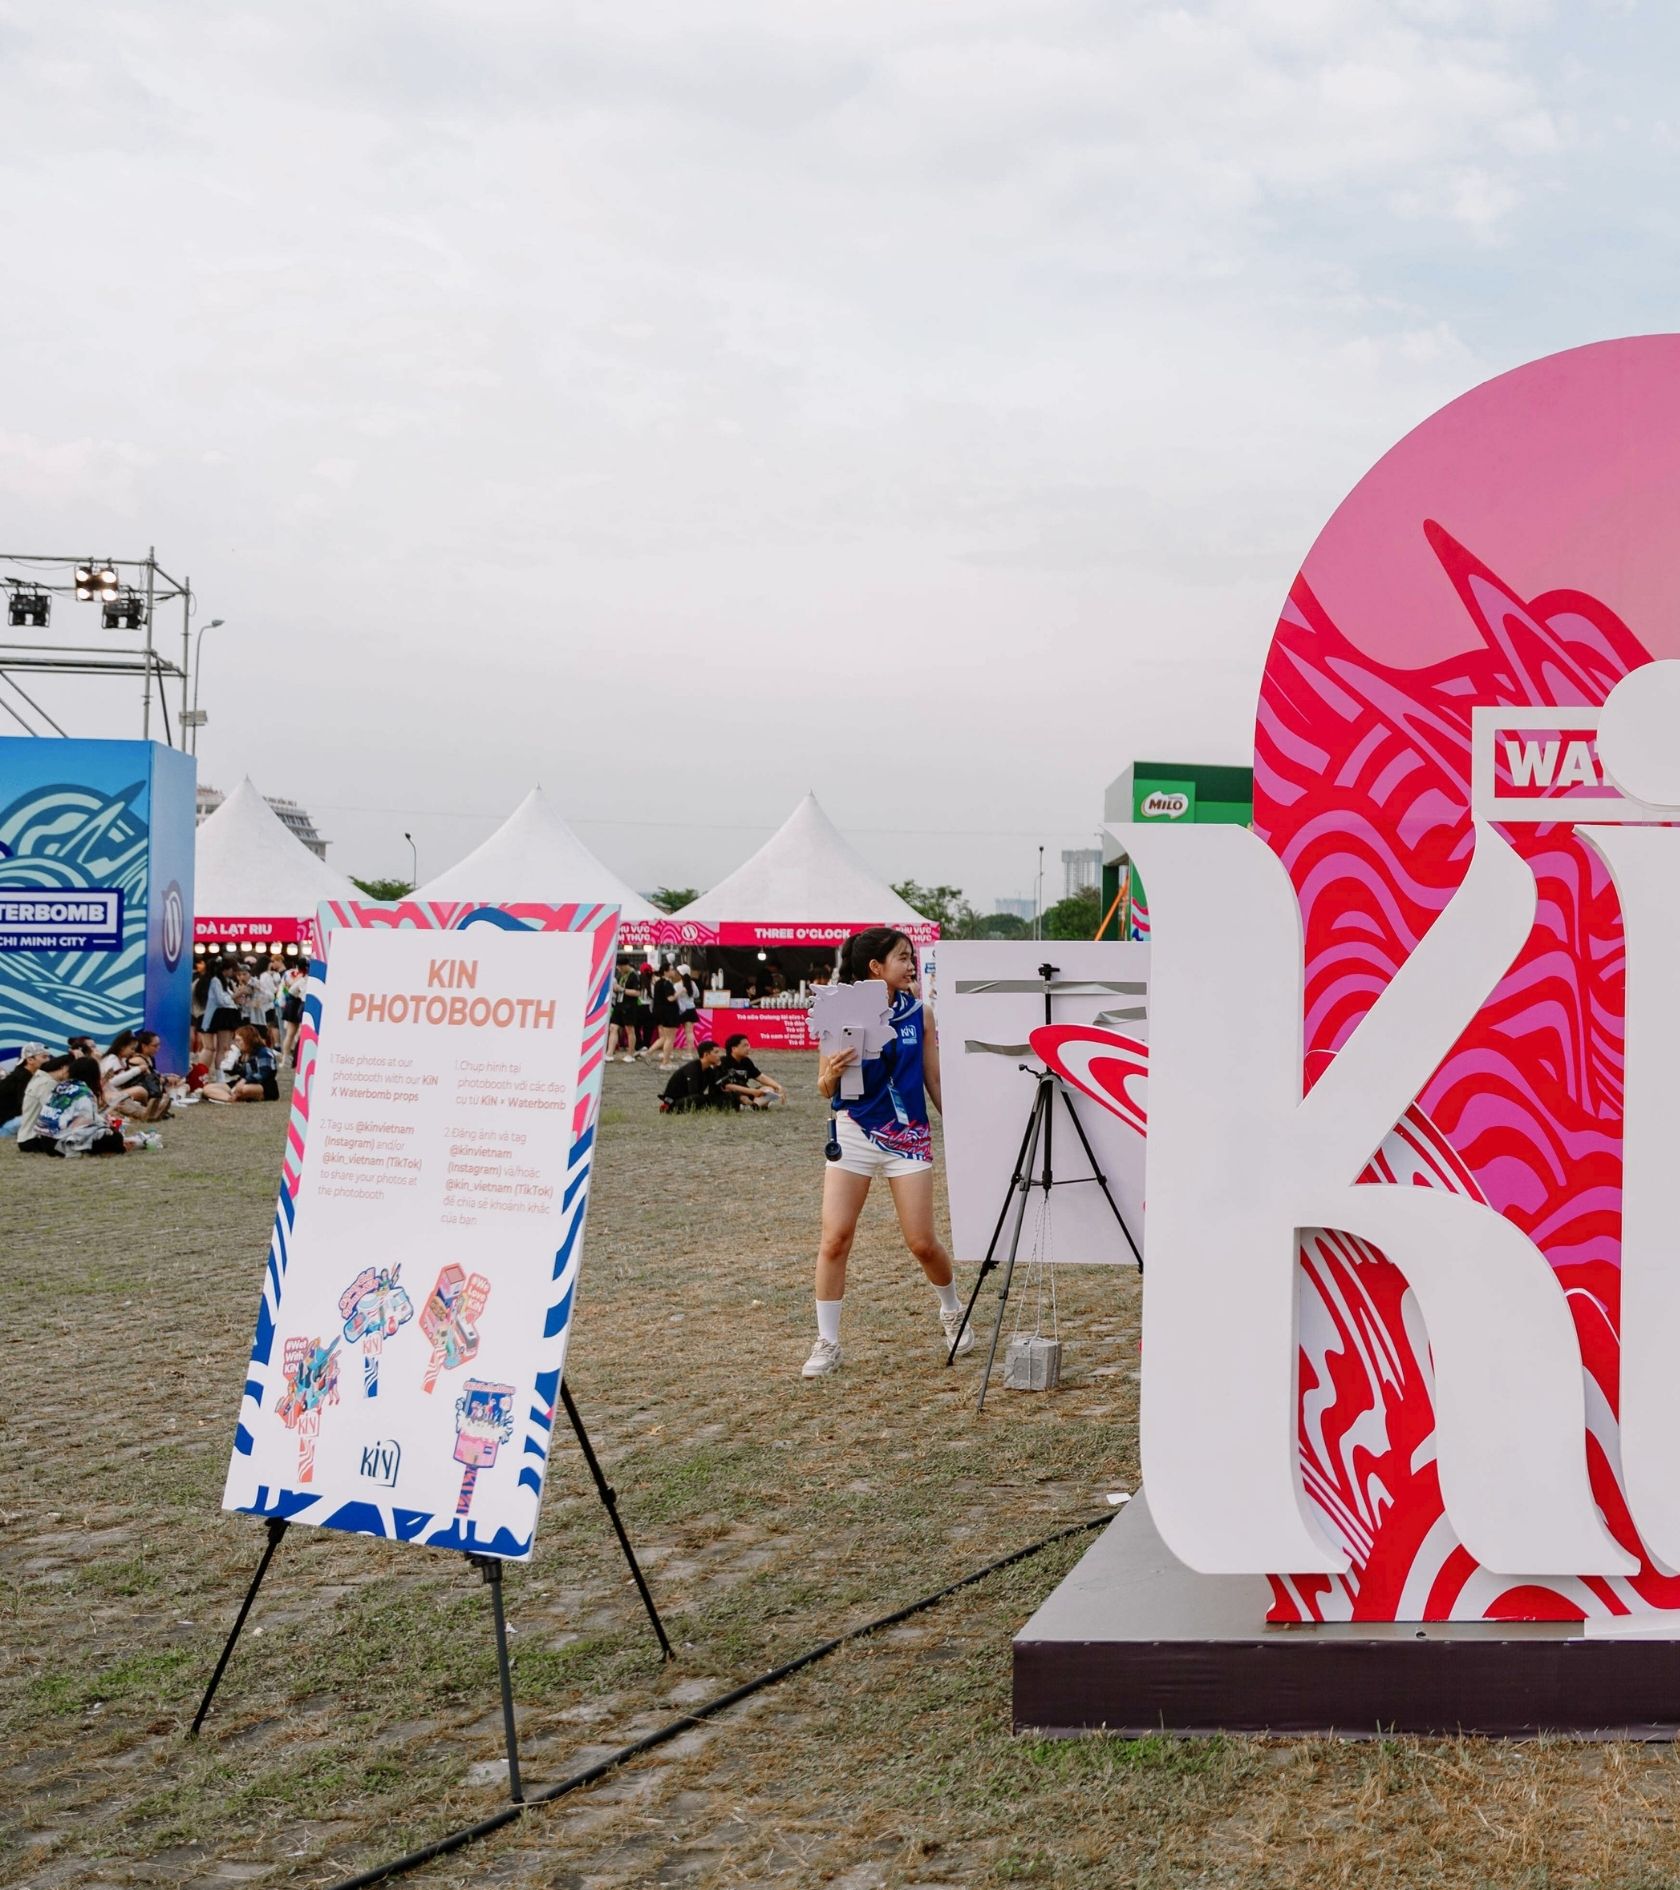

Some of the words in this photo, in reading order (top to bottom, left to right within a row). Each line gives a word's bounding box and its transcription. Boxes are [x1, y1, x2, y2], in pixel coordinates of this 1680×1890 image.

[1148, 799, 1183, 811] MILO
[195, 920, 218, 935] ĐÀ
[220, 923, 247, 937] LẠT
[248, 923, 273, 935] RIU
[754, 928, 794, 939] THREE
[796, 928, 851, 939] O'CLOCK
[20, 936, 56, 946] MINH
[59, 936, 87, 946] CITY
[427, 959, 478, 989] KIN
[348, 992, 556, 1029] PHOTOBOOTH
[356, 1055, 386, 1067] photos
[333, 1070, 383, 1082] photobooth
[384, 1072, 404, 1083] with
[339, 1087, 392, 1100] Waterbomb
[393, 1091, 419, 1103] props
[507, 1096, 566, 1110] Waterbomb
[344, 1122, 354, 1131] us
[356, 1121, 416, 1135] @kinvietnam
[324, 1135, 375, 1151] (Instagram)
[449, 1144, 513, 1159] @kinvietnam
[386, 1156, 422, 1171] (TikTok)
[447, 1161, 502, 1177] (Instagram)
[320, 1169, 330, 1178] to
[330, 1169, 354, 1181] share
[376, 1173, 408, 1185] photos
[318, 1185, 333, 1195] the
[333, 1186, 385, 1200] photobooth
[514, 1183, 554, 1199] (TikTok)
